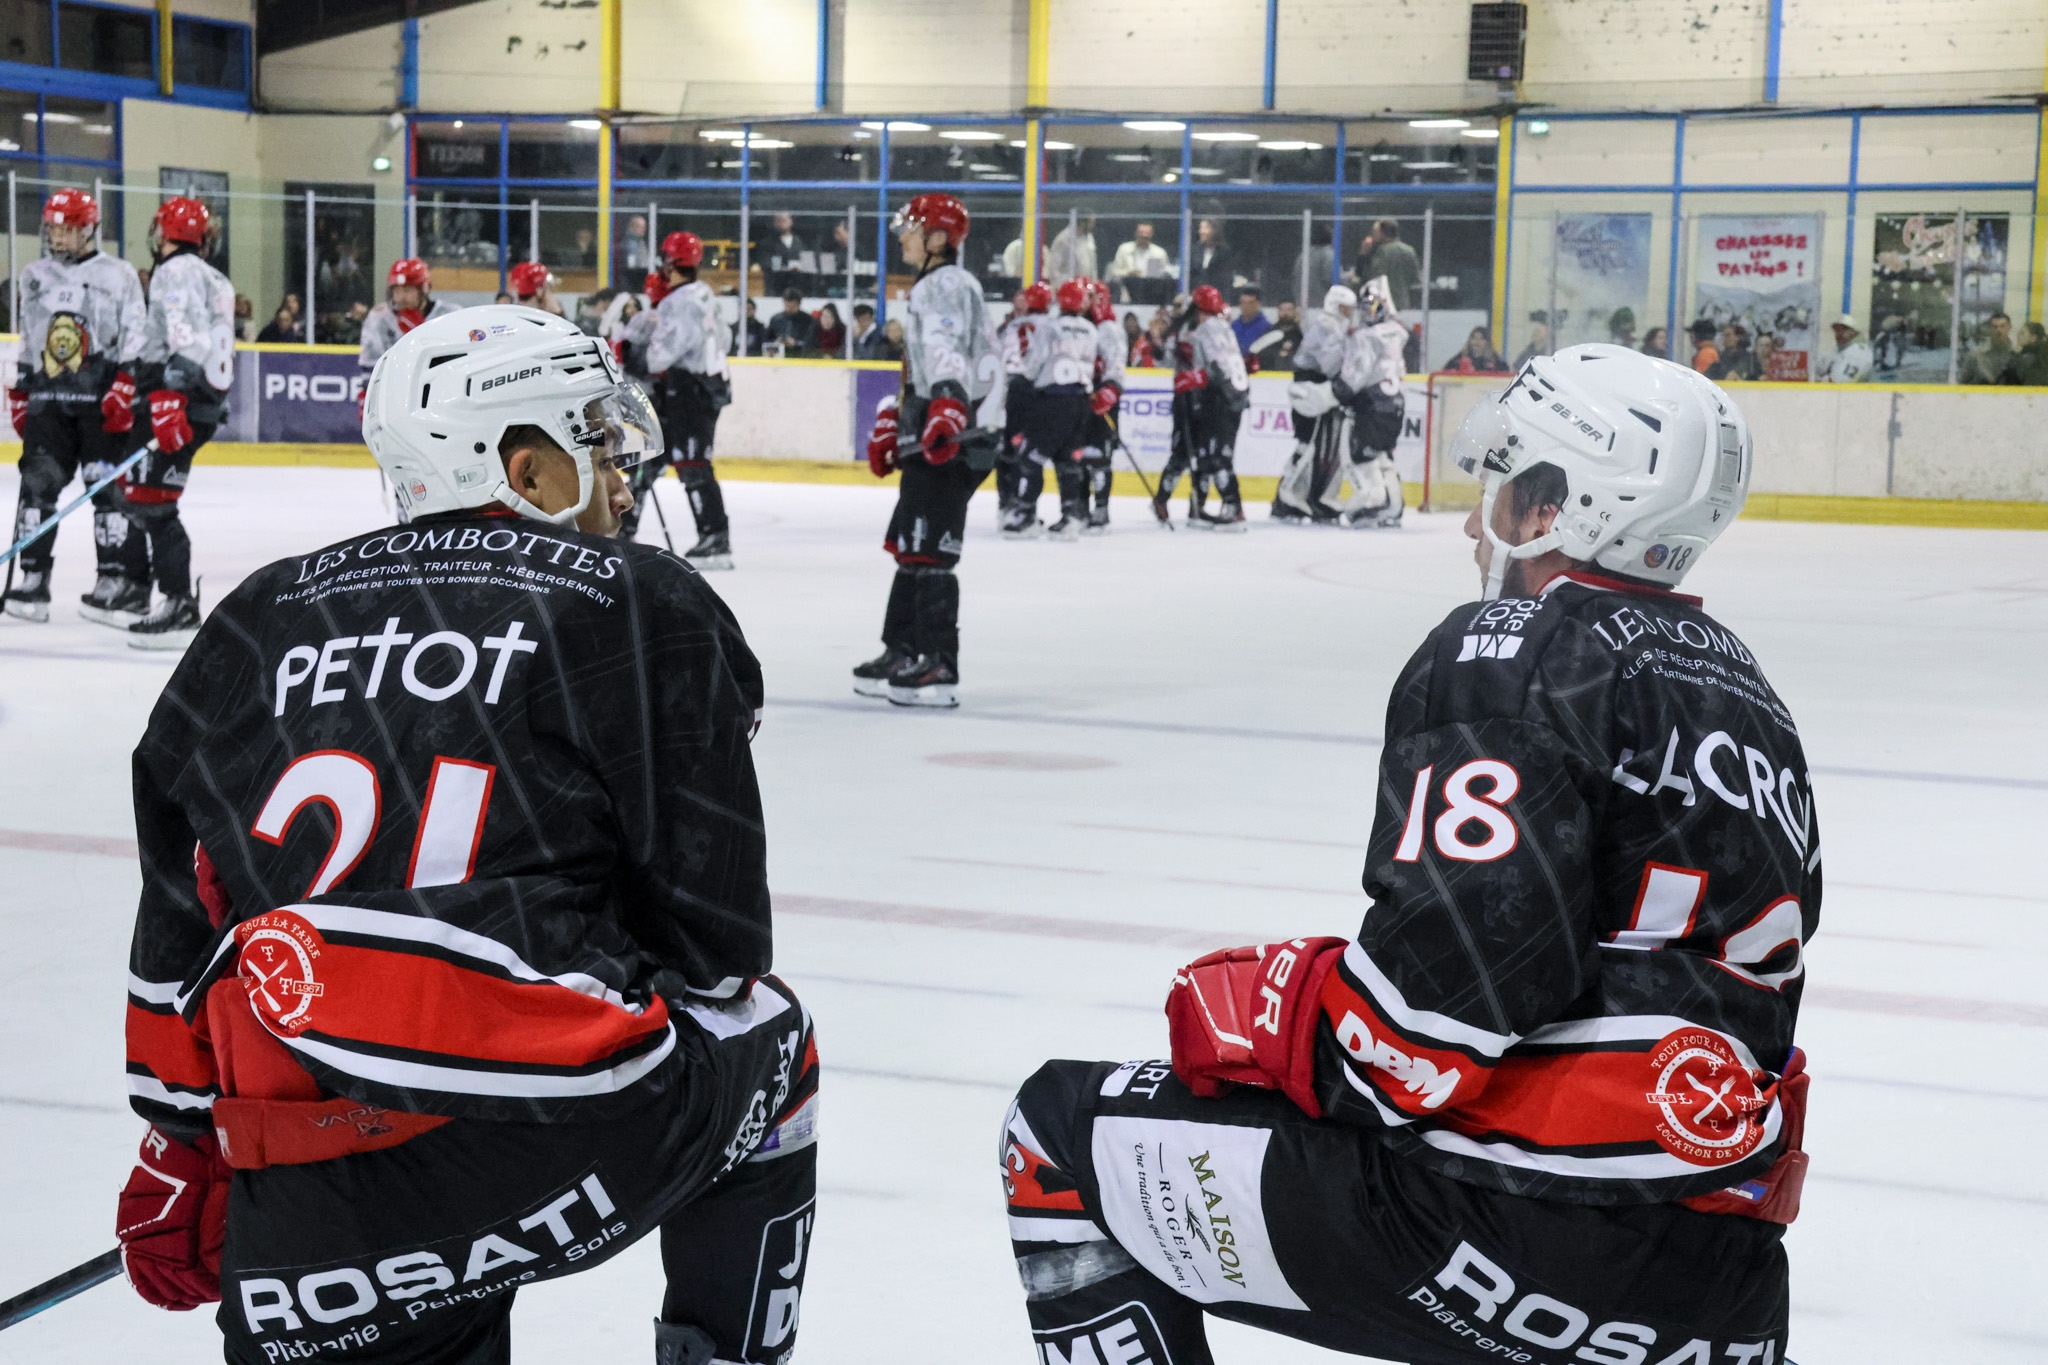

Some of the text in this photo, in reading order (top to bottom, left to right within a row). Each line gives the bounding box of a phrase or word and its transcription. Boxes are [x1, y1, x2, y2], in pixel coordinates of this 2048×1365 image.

[1716, 234, 1807, 250] CHAUSSEZ
[481, 366, 542, 392] BAUER
[1550, 402, 1604, 442] BAUER
[294, 528, 623, 584] LES COMBOTTES
[1666, 545, 1693, 571] 18
[275, 587, 317, 605] SALLES
[318, 577, 334, 591] DE
[336, 563, 411, 583] RÉCEPTION
[424, 561, 492, 573] TRAITEUR
[505, 564, 615, 608] HÉBERGEMENT
[304, 576, 550, 605] LE PARTENAIRE DE TOUTES VOS BONNES OCCASIONS
[1592, 607, 1657, 651] LES
[274, 617, 539, 718] PETOT
[1655, 648, 1669, 662] DE
[1669, 652, 1727, 677] RÉCEPTION
[1664, 670, 1704, 687] ARTENAIRE
[1706, 676, 1719, 686] DE
[250, 748, 498, 901] 21
[1393, 757, 1522, 863] 18
[272, 917, 289, 929] LA
[291, 923, 321, 960] TABLE
[1336, 1009, 1462, 1109] DBM
[1651, 1040, 1680, 1069] TOUT
[1681, 1035, 1712, 1049] POUR
[1134, 1142, 1144, 1168] Une
[1656, 1122, 1712, 1159] LOCATION
[1716, 1149, 1732, 1159] DE
[1138, 1171, 1154, 1222] tradition
[1148, 1223, 1162, 1240] qui
[1159, 1179, 1193, 1260] ROGER
[1188, 1150, 1246, 1289] MAISON
[240, 1172, 616, 1334] ROSATI
[405, 1269, 537, 1321] Peinture
[564, 1221, 628, 1262] Sols
[1163, 1250, 1177, 1262] du
[1172, 1263, 1185, 1282] bon
[1407, 1285, 1533, 1364] Plâtrerie
